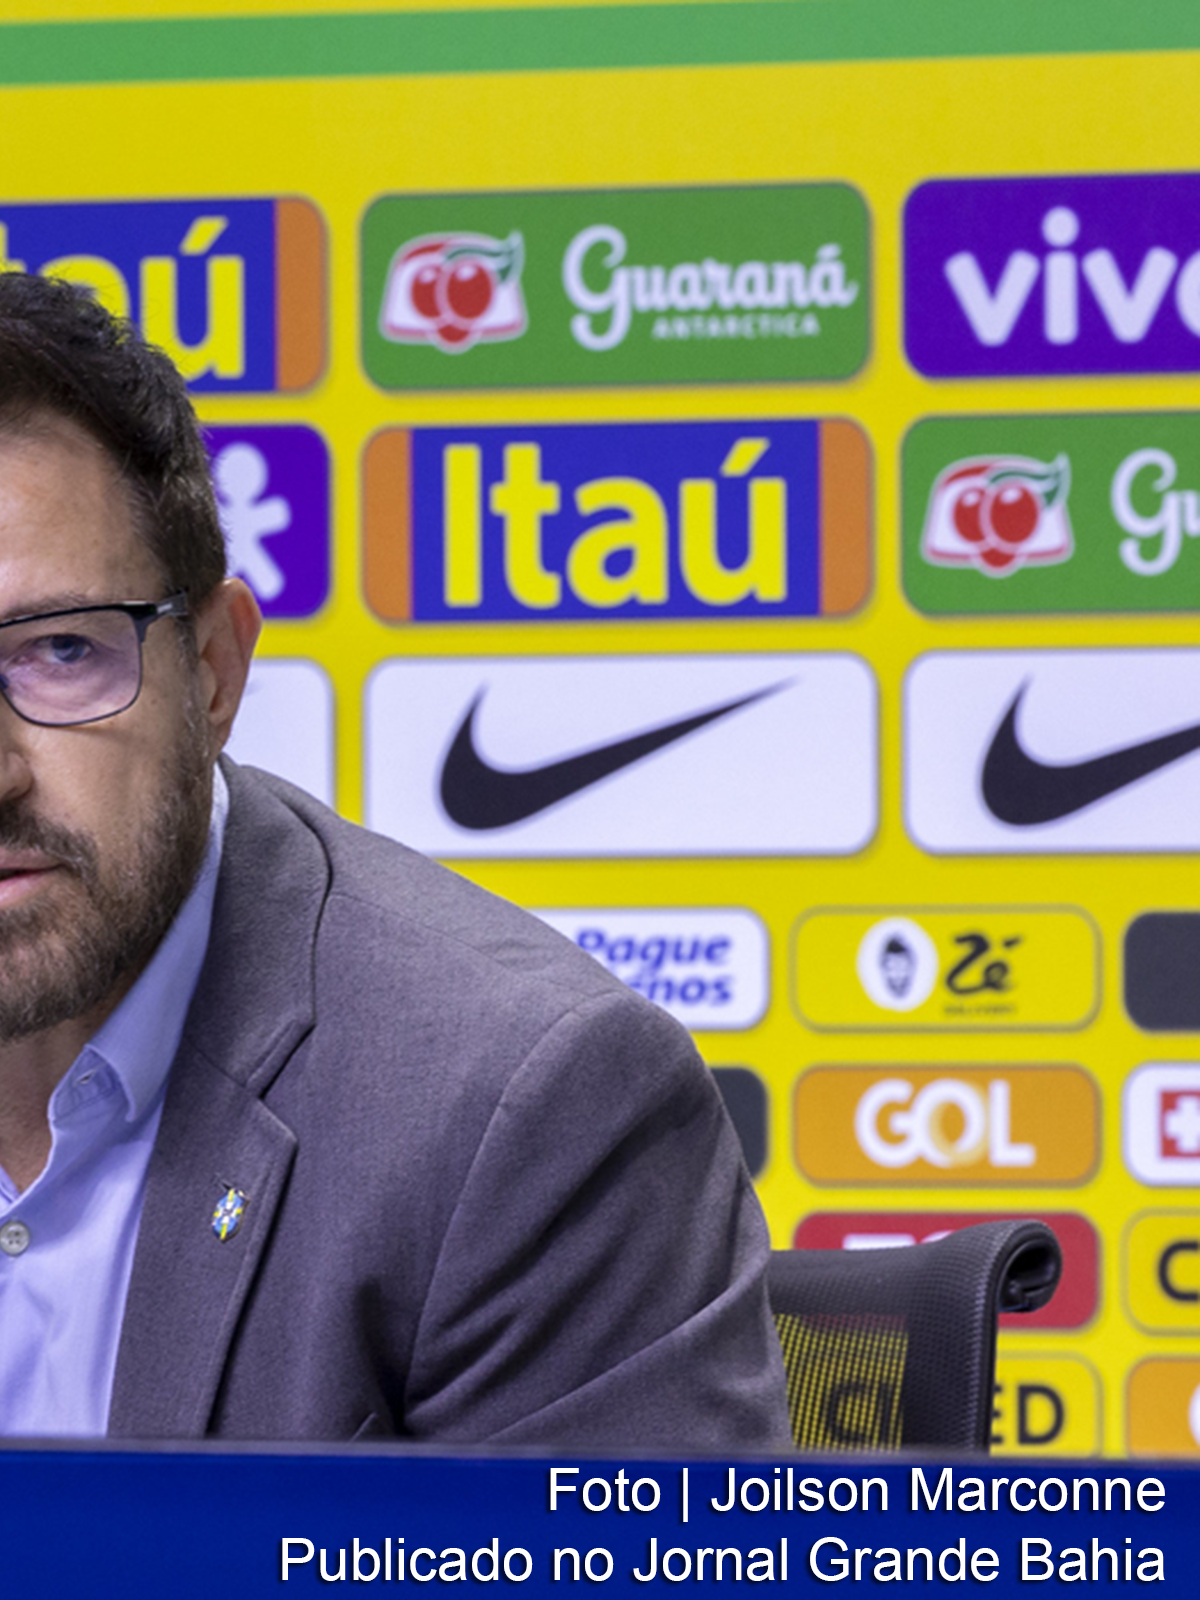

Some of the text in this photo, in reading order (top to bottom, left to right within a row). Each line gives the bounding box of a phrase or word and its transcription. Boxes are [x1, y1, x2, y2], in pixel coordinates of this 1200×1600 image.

[562, 224, 858, 352] Guaraná
[652, 314, 820, 340] ANTARCTICA
[443, 437, 788, 610] Itaú
[575, 928, 732, 970] Pague
[854, 1078, 1036, 1168] GOL
